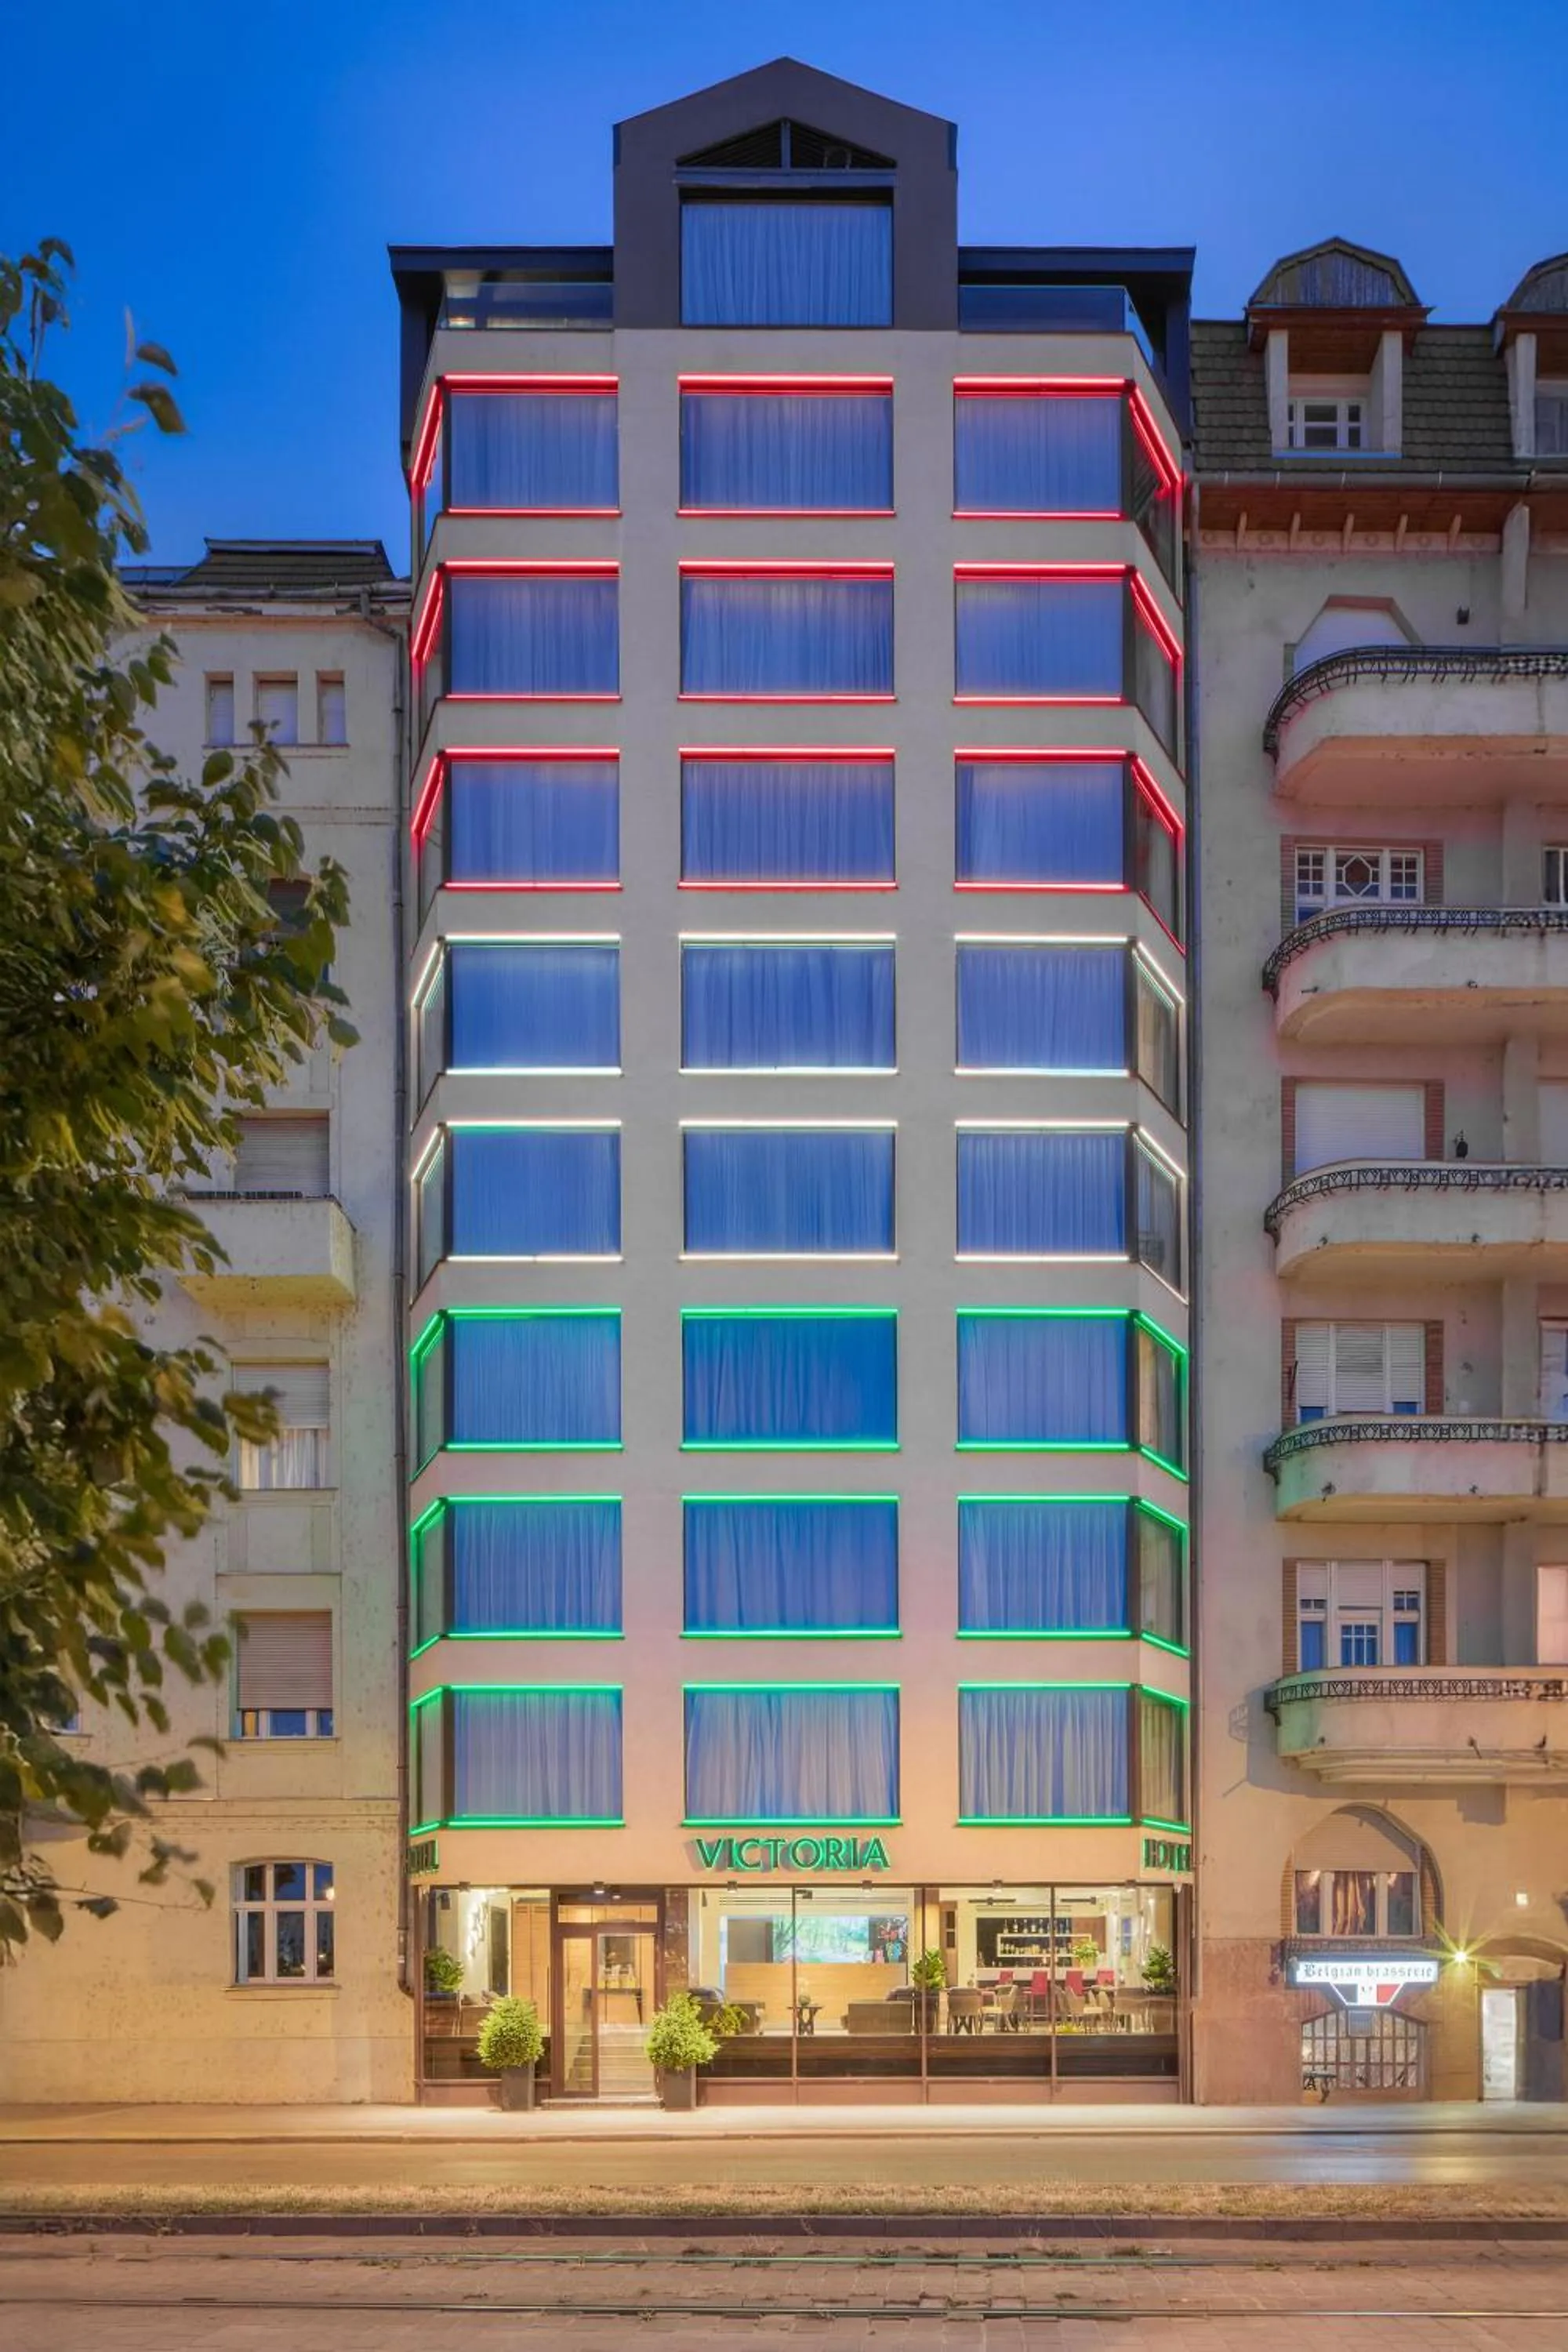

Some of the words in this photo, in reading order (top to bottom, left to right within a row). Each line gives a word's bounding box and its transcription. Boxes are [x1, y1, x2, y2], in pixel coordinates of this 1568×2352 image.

[695, 1837, 891, 1870] VICTORIA
[1304, 1963, 1362, 1980] Belgian
[1367, 1963, 1433, 1978] brasserie
